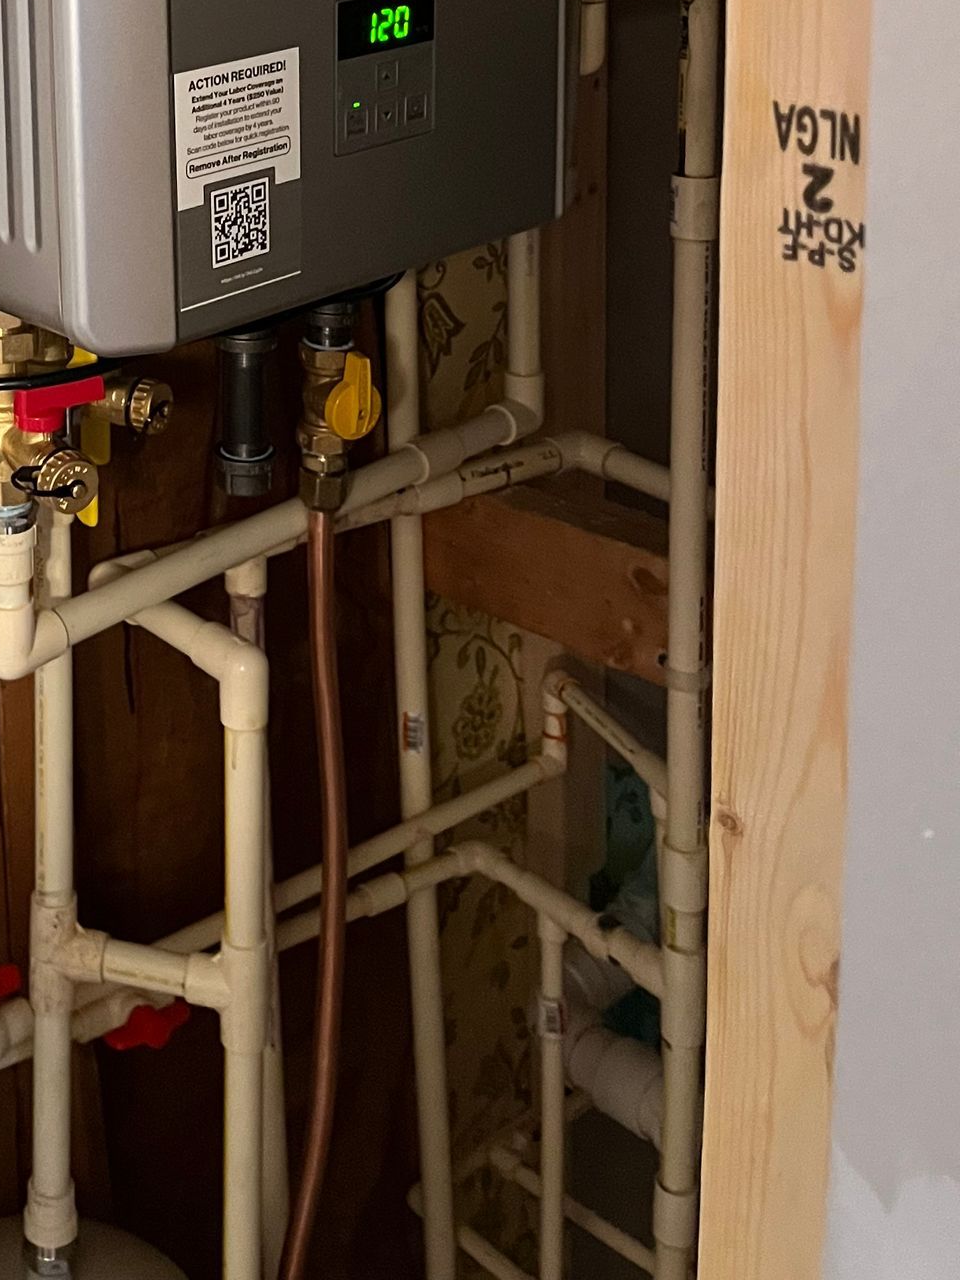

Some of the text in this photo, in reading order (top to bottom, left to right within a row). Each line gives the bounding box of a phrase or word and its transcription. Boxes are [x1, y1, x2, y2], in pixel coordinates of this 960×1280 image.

[370, 5, 410, 44] 120
[188, 60, 286, 92] ACTION REQUIRED!
[192, 92, 213, 103] Extend
[229, 87, 246, 95] Labor
[247, 80, 274, 91] Coverage
[192, 100, 222, 114] Additional
[228, 96, 245, 104] Years
[265, 86, 284, 96] Value)
[193, 125, 207, 133] days
[214, 116, 243, 128] installation
[251, 110, 270, 119] extend
[270, 107, 282, 115] your
[196, 112, 219, 123] Register
[220, 109, 232, 118] your
[233, 103, 255, 115] product
[187, 146, 201, 155] Scan
[202, 143, 216, 151] code
[218, 137, 234, 147] below
[204, 132, 218, 140] labor
[219, 127, 244, 137] coverage
[772, 100, 860, 165] NLGA
[189, 143, 287, 173] Remove After Registration
[802, 163, 834, 213] 2
[778, 208, 865, 248] KD-HT
[782, 235, 857, 273] S-P-F
